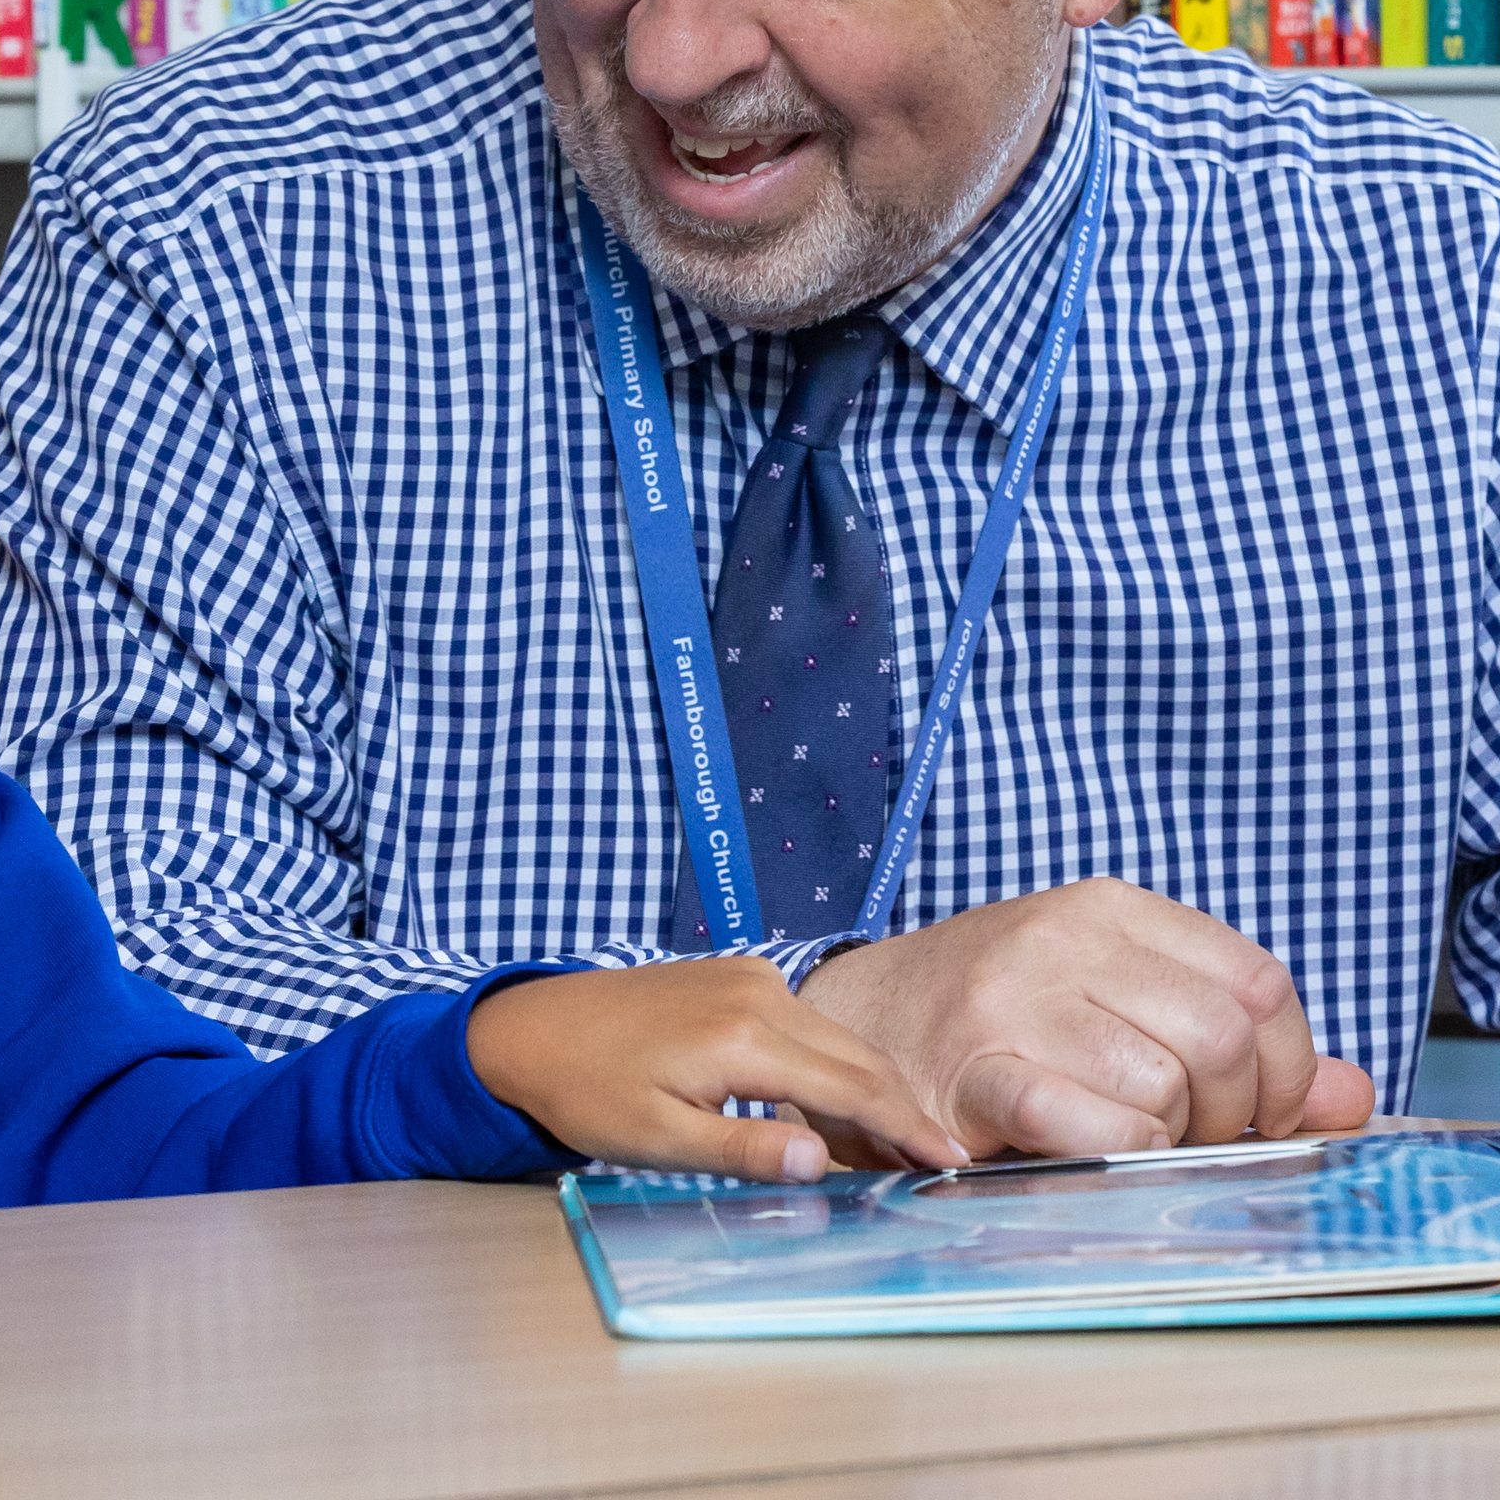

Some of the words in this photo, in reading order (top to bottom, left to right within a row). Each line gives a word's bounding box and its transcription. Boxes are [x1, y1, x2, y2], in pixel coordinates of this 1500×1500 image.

[614, 305, 645, 410] Primary
[634, 417, 668, 513] School
[1004, 326, 1066, 501] Farmborough
[1061, 222, 1090, 320] Church
[672, 636, 723, 823] Farmborough
[708, 828, 744, 930] Church
[866, 826, 908, 921] Church
[903, 716, 943, 820] Primary
[938, 618, 975, 711] School
